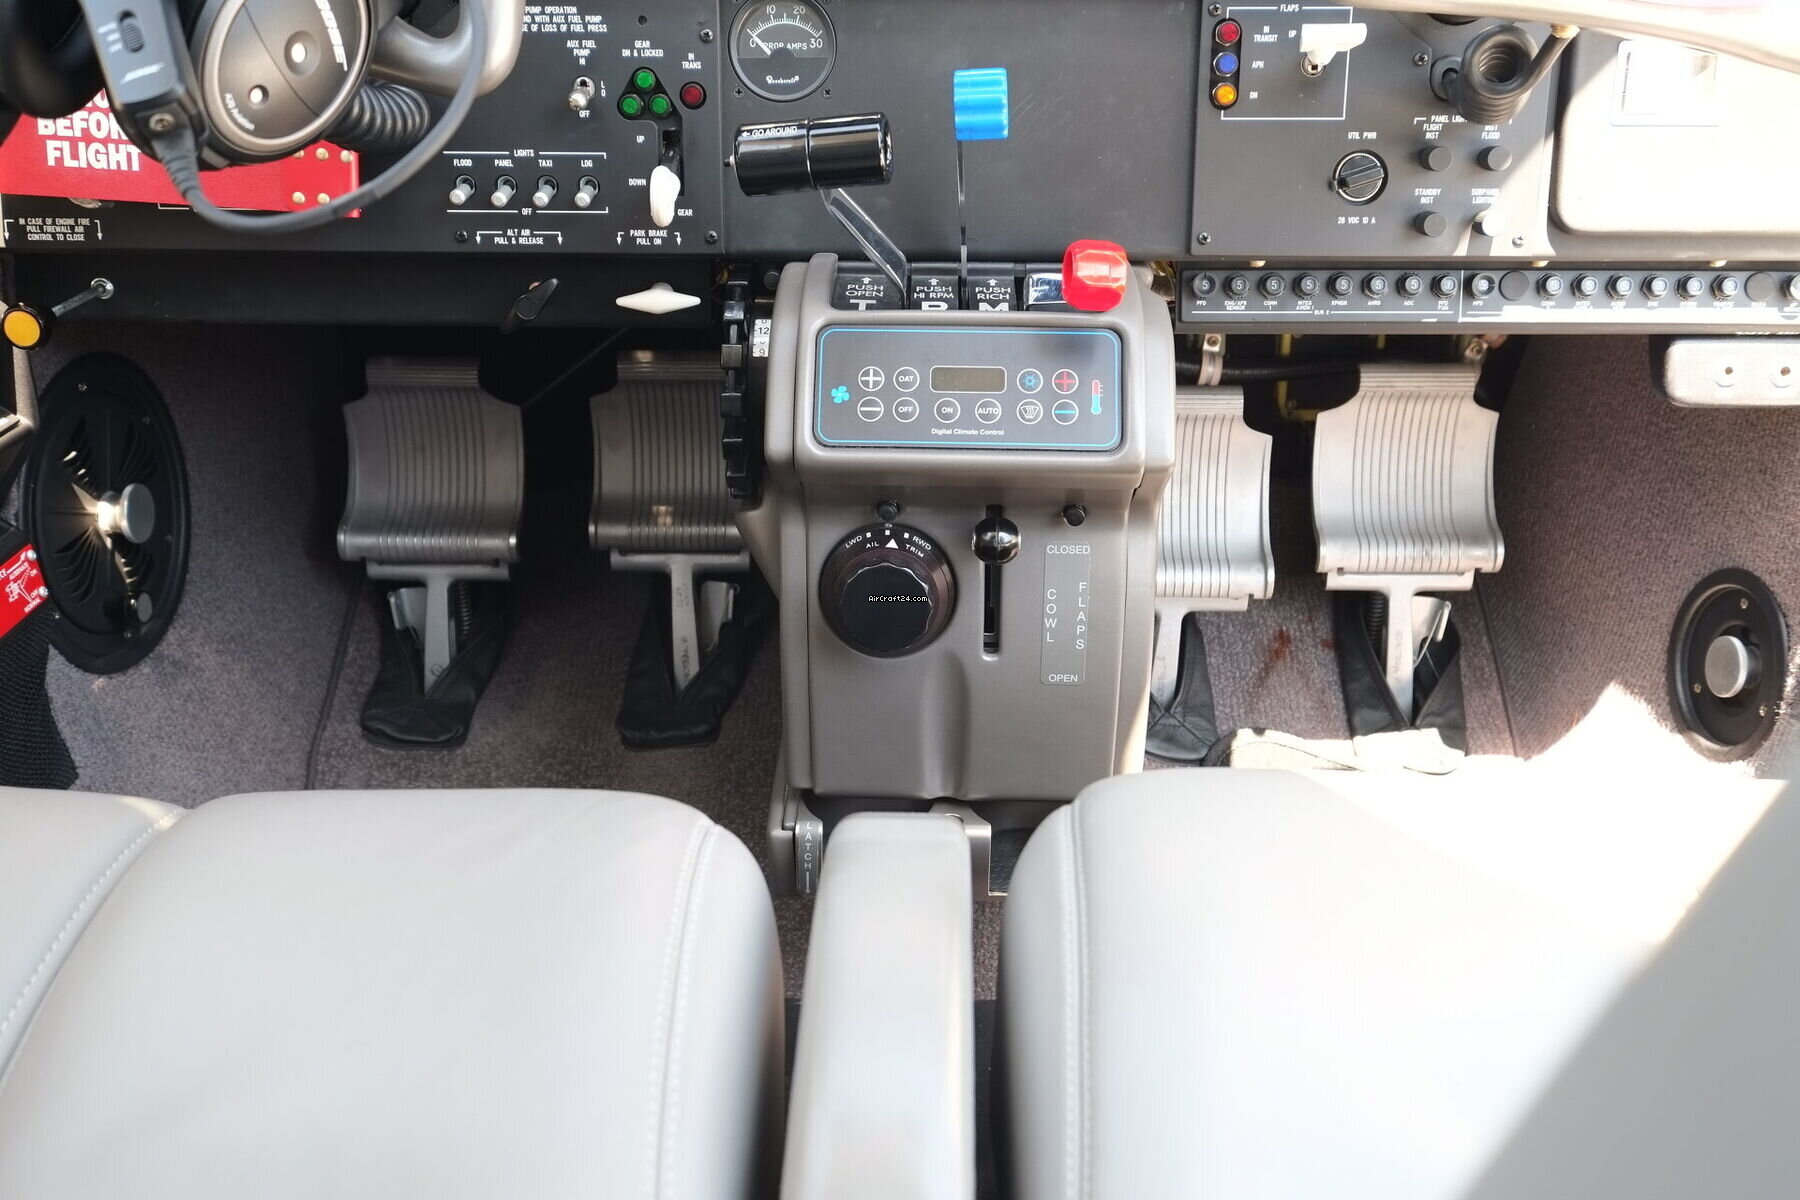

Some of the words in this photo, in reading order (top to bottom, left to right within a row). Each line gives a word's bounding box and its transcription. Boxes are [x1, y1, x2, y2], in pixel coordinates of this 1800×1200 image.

[525, 6, 542, 14] PUMP
[545, 6, 578, 15] OPERATION
[766, 5, 777, 15] 10
[793, 6, 806, 14] 20
[1280, 4, 1300, 12] FLAPS
[534, 15, 550, 23] WITH
[553, 15, 566, 24] AUX
[568, 15, 583, 24] FUEL
[585, 16, 603, 24] PUMP
[531, 24, 539, 32] OF
[542, 24, 558, 33] LOSS
[560, 24, 568, 33] OF
[571, 24, 585, 33] FUEL
[588, 24, 608, 33] PRESS
[1264, 26, 1270, 34] IN
[1289, 30, 1297, 38] UP
[1254, 35, 1279, 43] TRANSIT
[567, 40, 580, 48] AUX
[582, 40, 597, 49] FUEL
[635, 41, 651, 49] GEAR
[749, 39, 757, 48] 0
[809, 39, 823, 49] 30
[574, 49, 591, 57] PUMP
[622, 49, 631, 57] DN
[634, 49, 639, 57] &
[641, 49, 664, 57] LOCKED
[688, 53, 695, 61] IN
[579, 58, 586, 66] HI
[682, 62, 702, 70] TRANS
[1252, 61, 1265, 69] APH
[1250, 92, 1259, 100] DN
[579, 110, 591, 118] OFF
[1431, 115, 1450, 123] PANEL
[1451, 115, 1468, 123] LIGH
[752, 129, 764, 137] GO
[764, 126, 798, 136] AROUND
[637, 136, 645, 144] UP
[1348, 132, 1361, 140] UTIL
[1363, 132, 1377, 140] PWR
[1426, 132, 1440, 140] INST
[1482, 132, 1501, 140] FLOOD
[46, 139, 142, 171] FLIGHT
[514, 149, 535, 157] LIGHTS
[454, 159, 473, 167] FLOOD
[495, 159, 514, 167] PANEL
[538, 160, 553, 168] TAXI
[581, 160, 593, 168] LDG
[522, 208, 533, 216] OFF
[678, 209, 693, 217] GEAR
[507, 229, 519, 237] ALT
[630, 229, 646, 237] PARK
[648, 229, 668, 237] BRAKE
[66, 234, 85, 242] CLOSE
[495, 237, 509, 245] PULL
[520, 237, 544, 245] RELEASE
[637, 238, 651, 246] PULL
[655, 238, 662, 246] ON
[1202, 281, 1209, 290] 5
[1236, 281, 1243, 290] 5
[1271, 281, 1278, 290] 5
[1306, 281, 1313, 289] 5
[1341, 281, 1348, 290] 5
[1376, 281, 1382, 289] 5
[1410, 281, 1418, 289] 5
[845, 290, 884, 298] OPEN
[758, 327, 770, 335] 12
[898, 375, 914, 383] OAT
[898, 405, 914, 413] OFF
[977, 407, 999, 415] AUTO
[931, 428, 953, 436] Digital
[980, 428, 1005, 436] Control
[845, 535, 863, 549] LWD
[912, 535, 932, 551] RWD
[866, 541, 880, 549] AIL
[905, 543, 924, 558] TRIM
[1047, 545, 1090, 554] CLOSED
[1045, 588, 1057, 642] COWL
[1076, 581, 1087, 650] FLAPS
[1048, 673, 1078, 683] OPEN
[804, 822, 813, 869] LATCH
